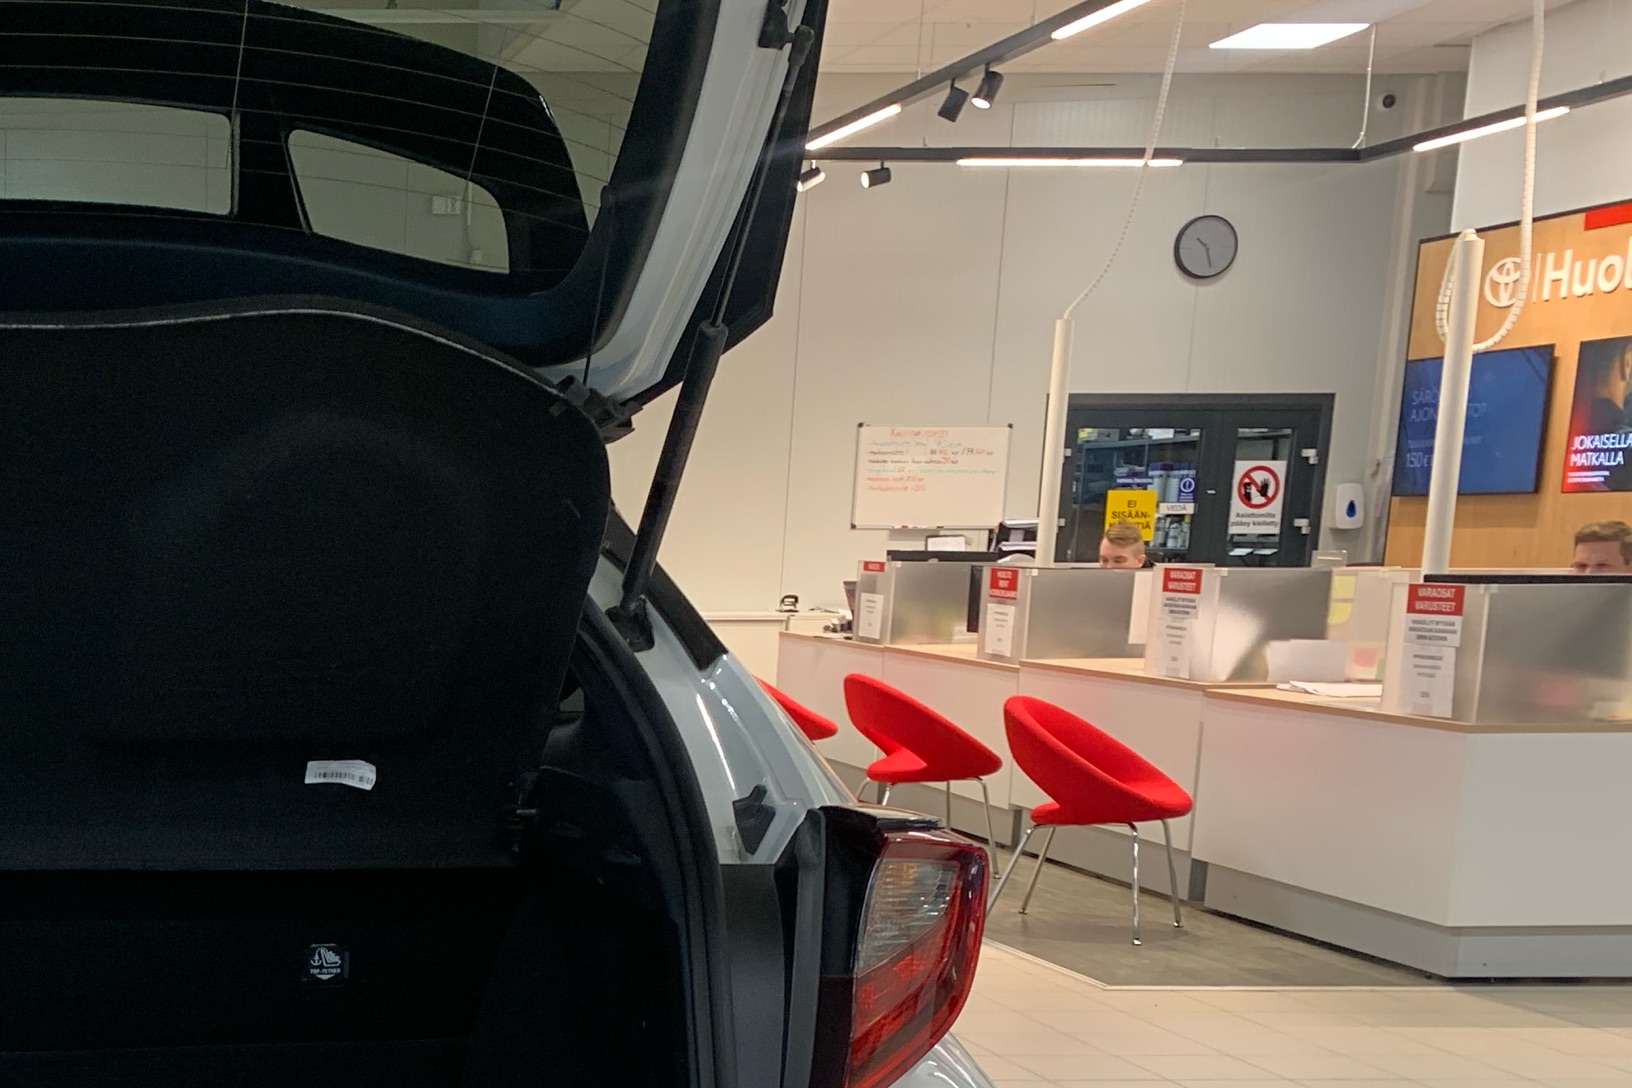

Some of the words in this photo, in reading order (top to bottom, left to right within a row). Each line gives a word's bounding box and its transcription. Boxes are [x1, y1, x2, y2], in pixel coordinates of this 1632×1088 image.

[1570, 451, 1624, 467] MATKALLA
[1127, 500, 1137, 509] EI
[1111, 510, 1151, 519] SISÄÄN-
[1414, 600, 1456, 612] VARUSTEET
